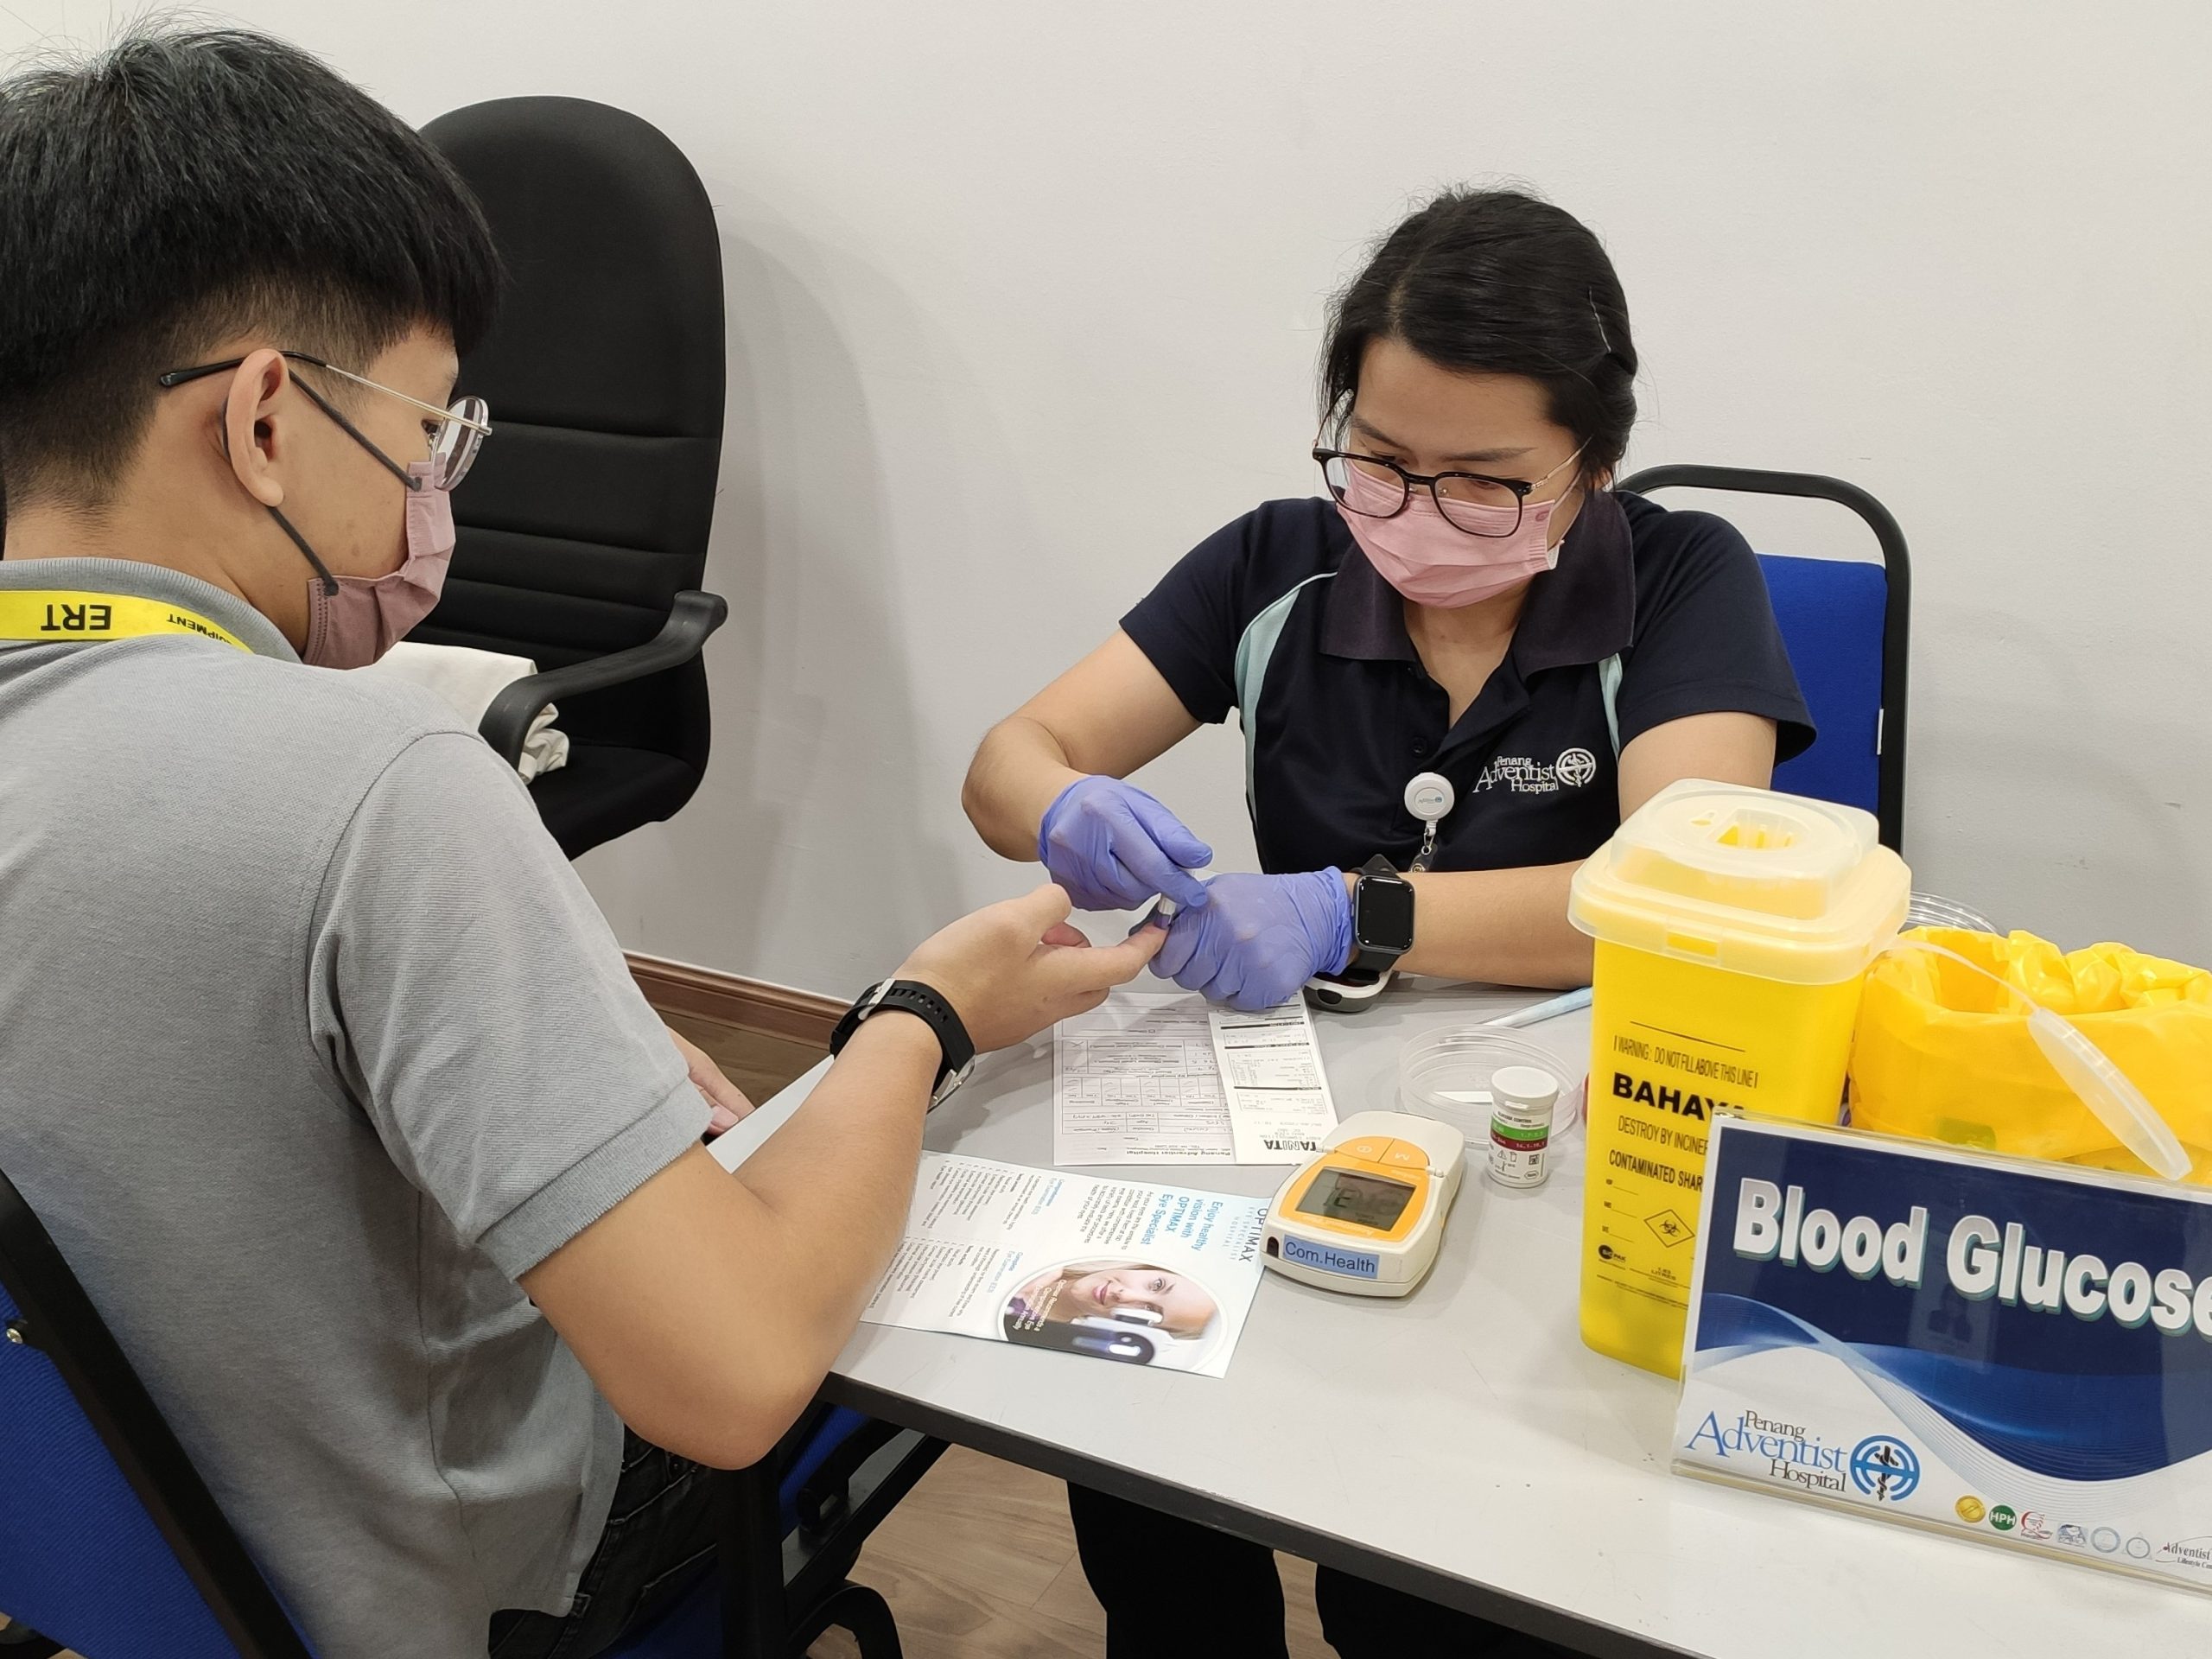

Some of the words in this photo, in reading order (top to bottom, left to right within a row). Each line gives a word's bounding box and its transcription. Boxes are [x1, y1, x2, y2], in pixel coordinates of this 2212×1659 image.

[41, 604, 111, 631] ERT
[167, 613, 232, 645] UIPMENT
[1472, 761, 1554, 792] Adventist
[1497, 756, 1532, 767] Penang
[1511, 777, 1559, 794] Hospital
[1654, 1046, 1665, 1065] DO
[1666, 1050, 1681, 1068] NOT
[1681, 1053, 1694, 1072] FILL
[1695, 1058, 1719, 1079] ABOVE
[1720, 1064, 1736, 1083] THIS
[1737, 1068, 1754, 1088] LINE
[1612, 1071, 1744, 1121] BAHAY
[1264, 1138, 1317, 1152] TANITA
[1618, 1115, 1659, 1142] DESTROY
[1660, 1128, 1673, 1147] BY
[1609, 1149, 1675, 1184] CONTAMINATED
[1678, 1171, 1704, 1192] SHAR
[1156, 1193, 1173, 1207] Eye
[1165, 1196, 1189, 1232] OPTIMAX
[1187, 1198, 1206, 1220] vision
[1203, 1201, 1223, 1222] Enjoy
[1140, 1209, 1166, 1245] Specialist
[1179, 1222, 1196, 1238] with
[1191, 1223, 1213, 1250] healthy
[1237, 1207, 1268, 1263] OPTIMAX
[1732, 1177, 1929, 1288] Blood
[1285, 1242, 1376, 1274] Com.Health
[1684, 1410, 1848, 1473] Adventist
[1744, 1410, 1807, 1442] Penang
[1770, 1459, 1846, 1492] Hospital
[1989, 1511, 2017, 1528] HPH
